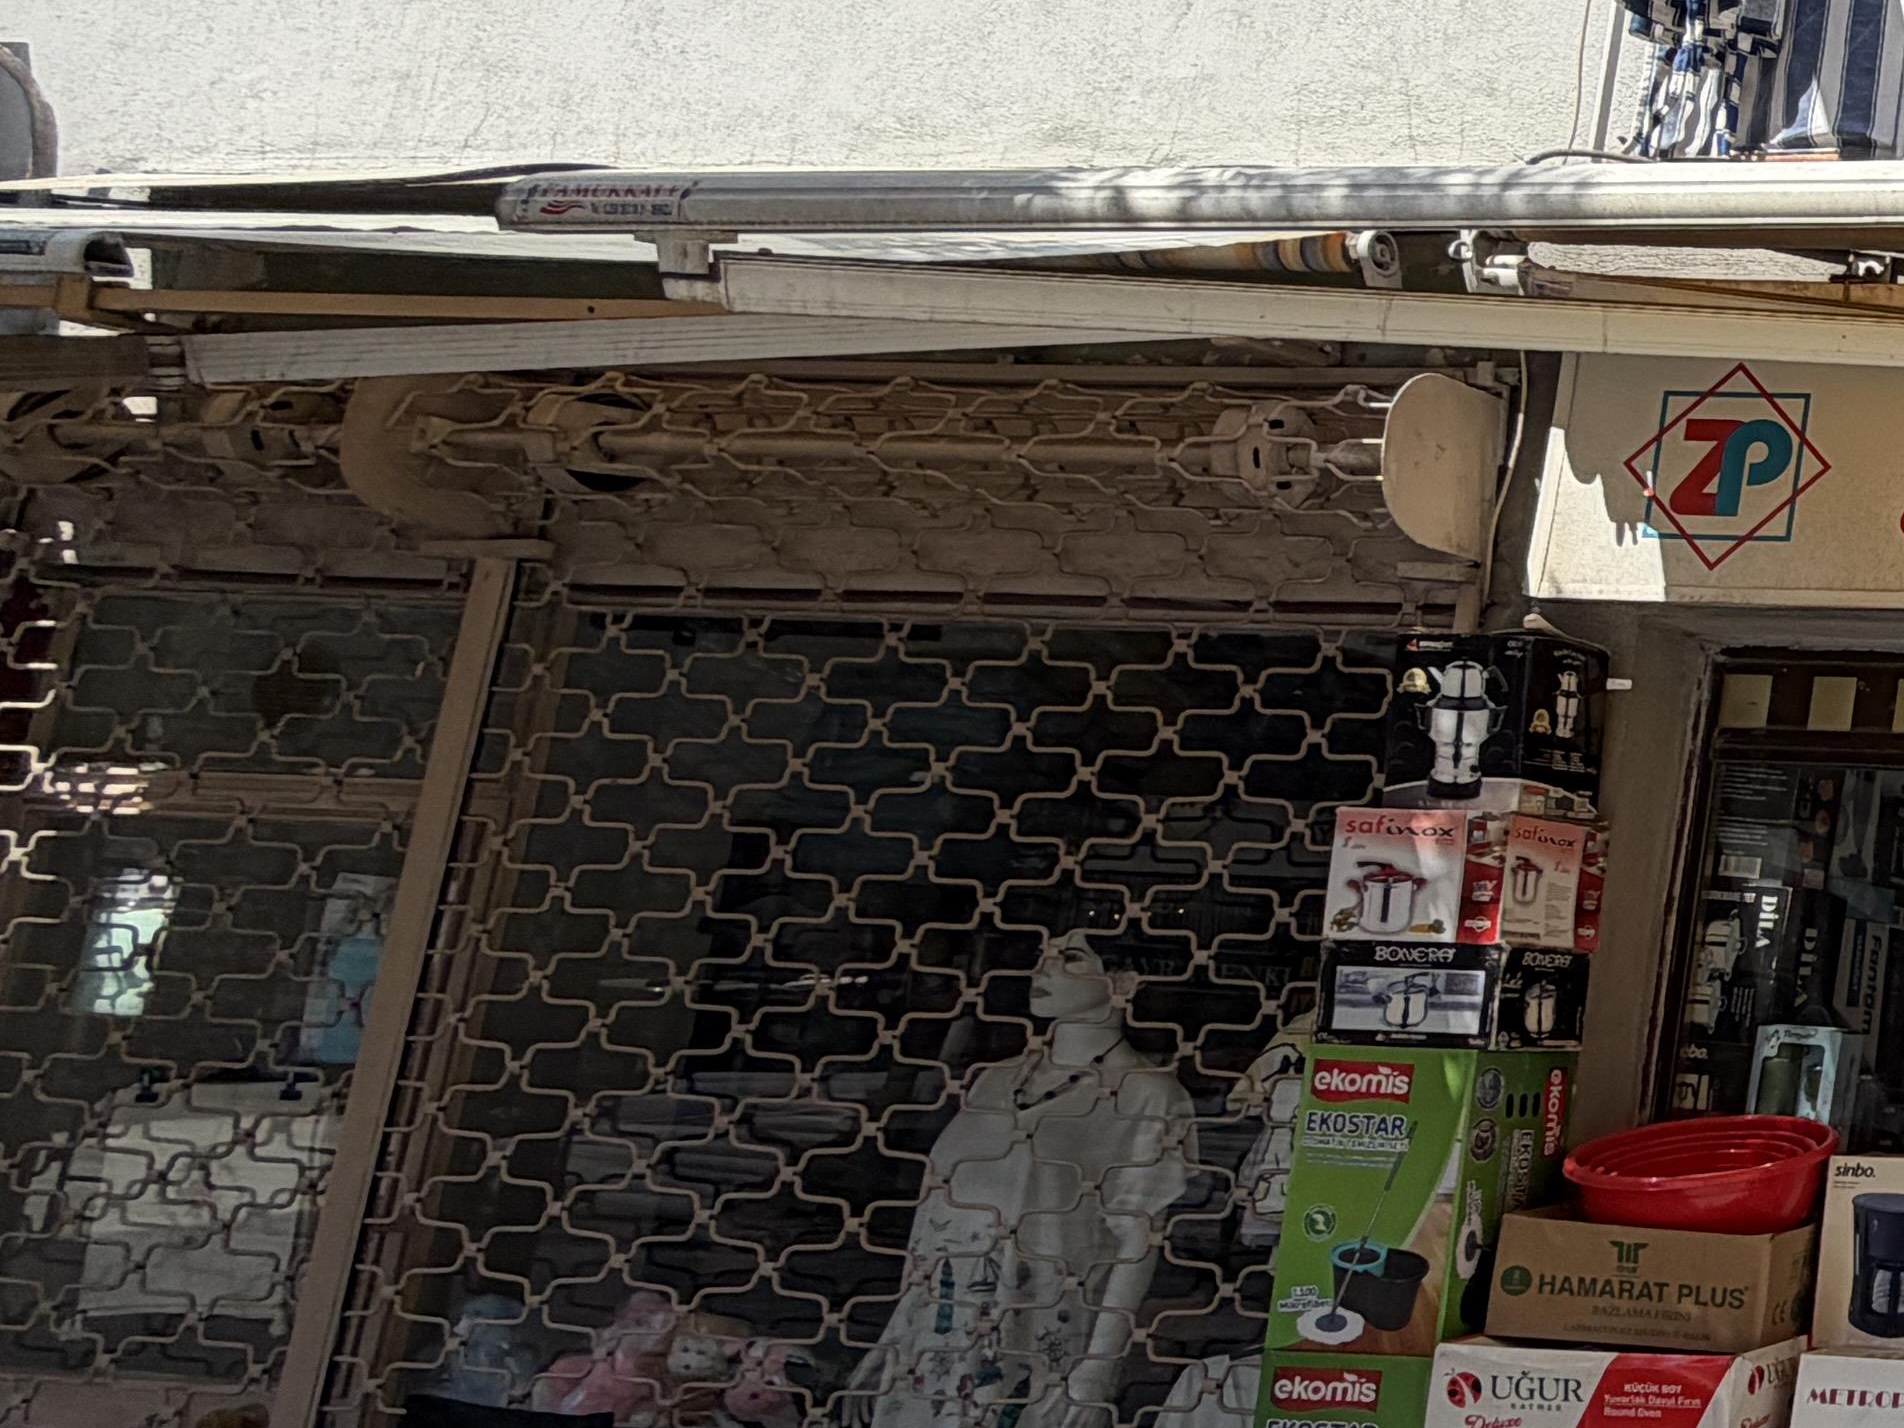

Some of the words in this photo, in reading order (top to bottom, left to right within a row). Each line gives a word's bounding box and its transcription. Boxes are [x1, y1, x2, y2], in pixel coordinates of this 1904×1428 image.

[1670, 417, 1794, 518] ZP
[1345, 815, 1455, 838] safinox
[1513, 825, 1578, 848] safinox
[1313, 1065, 1411, 1095] ekomis
[1305, 1112, 1408, 1139] EKOSTAR
[1513, 1129, 1535, 1212] EKOSTA
[1537, 1274, 1669, 1304] HAMARAT
[1677, 1283, 1745, 1309] PLUS
[1274, 1375, 1377, 1403] ekomis
[1491, 1371, 1584, 1403] UĞUR
